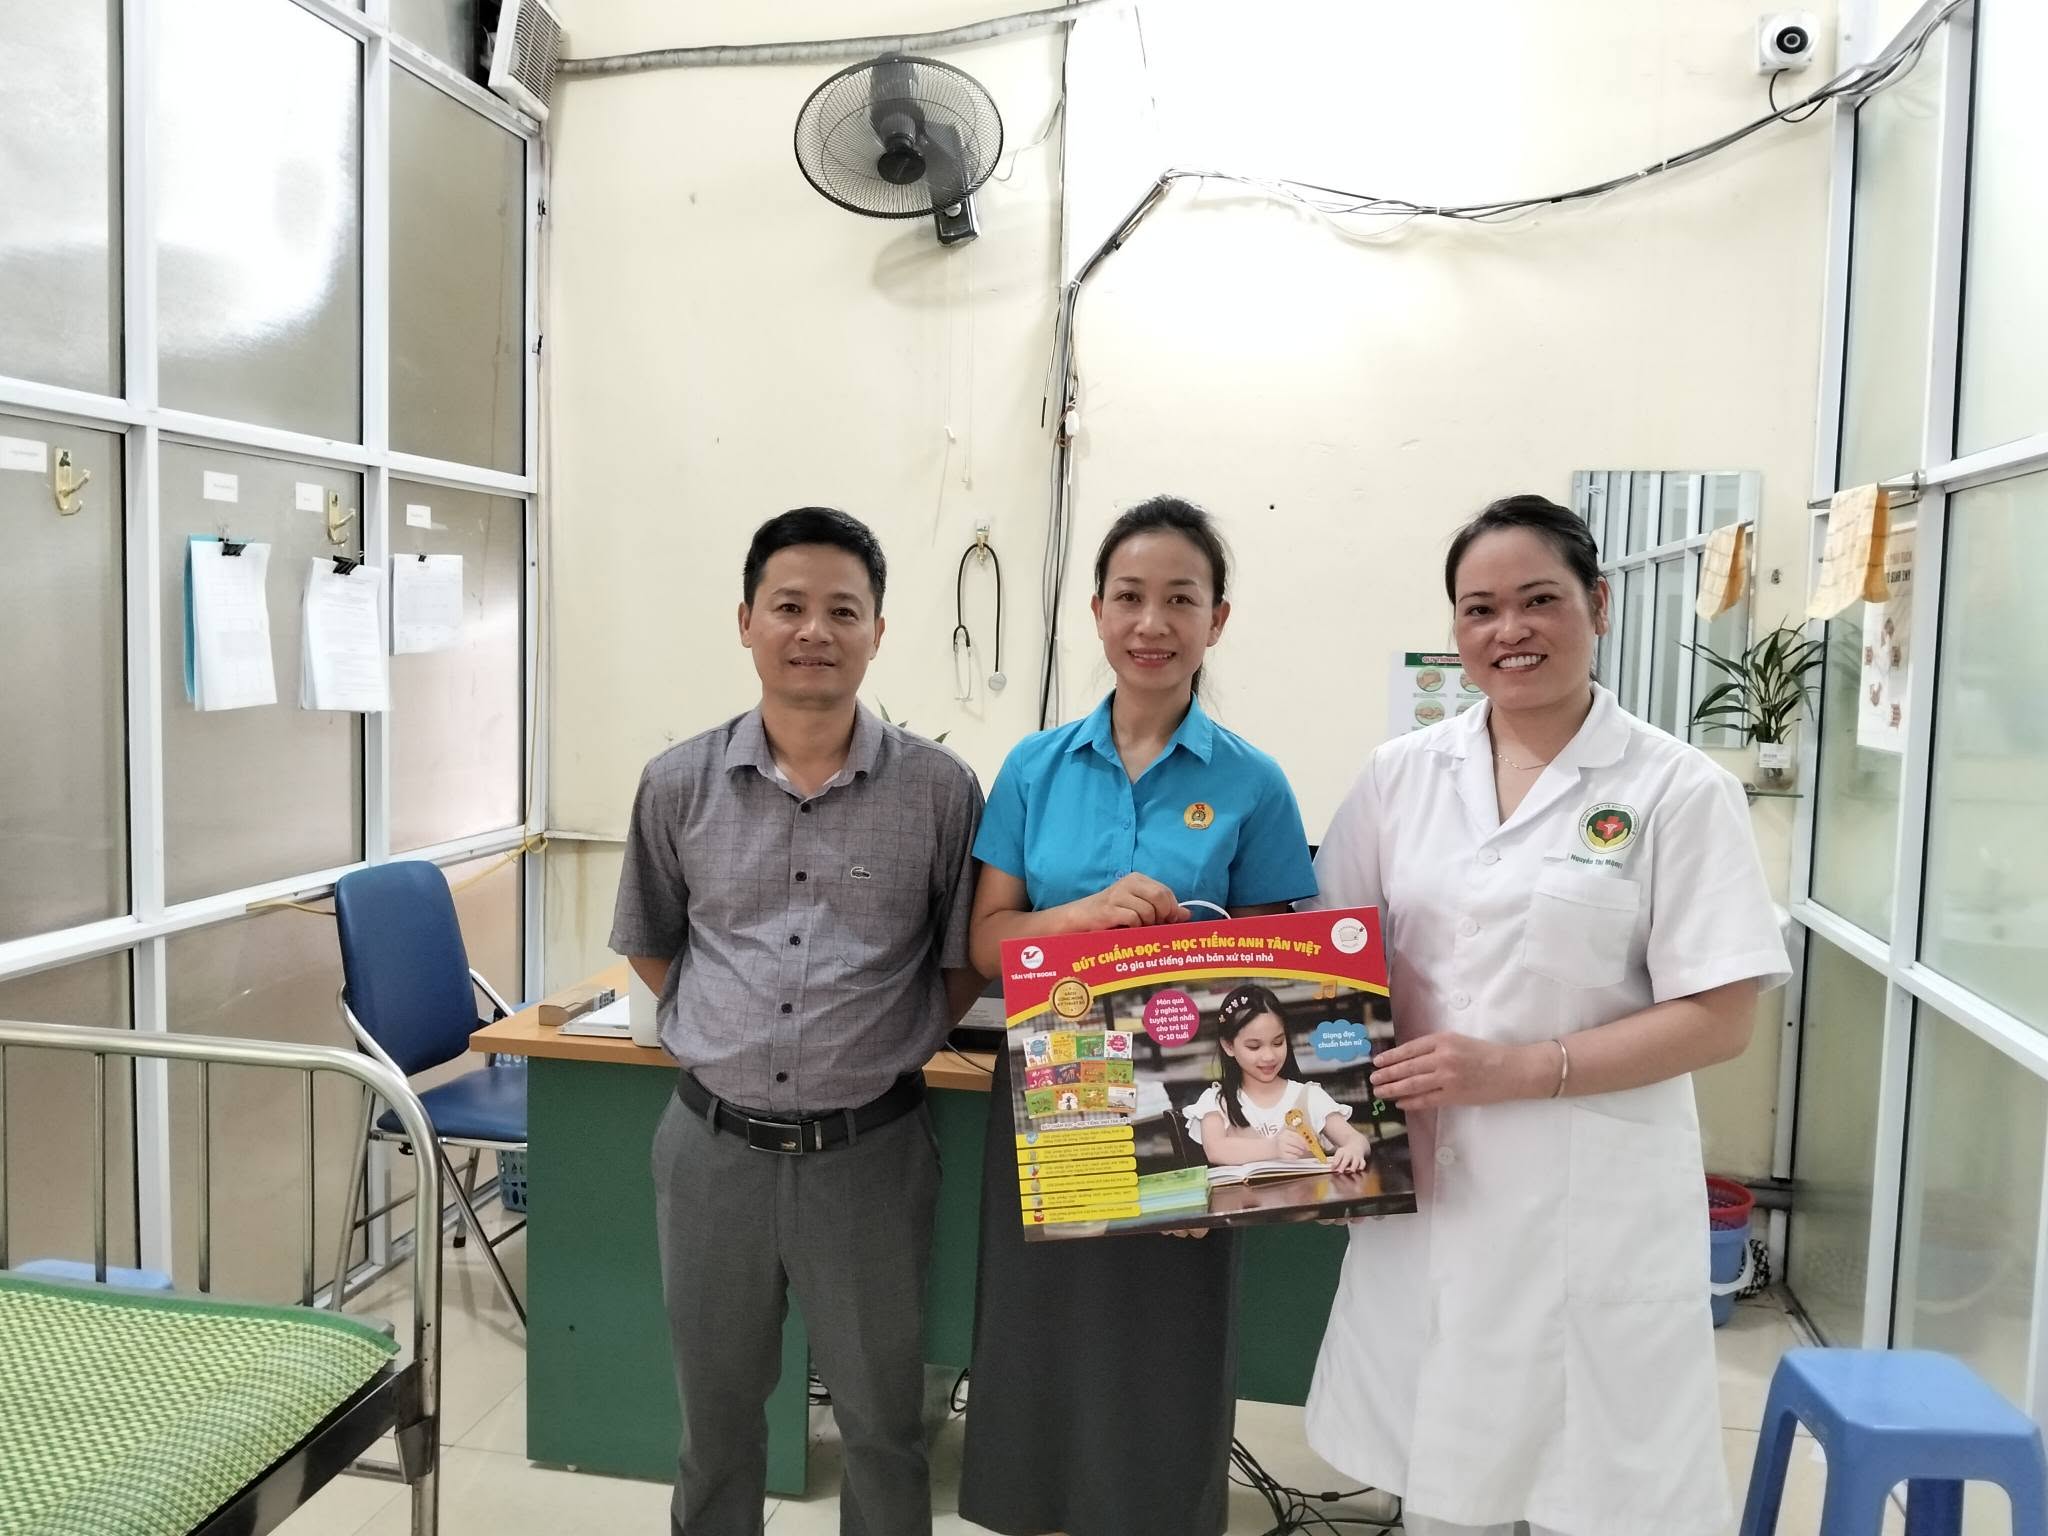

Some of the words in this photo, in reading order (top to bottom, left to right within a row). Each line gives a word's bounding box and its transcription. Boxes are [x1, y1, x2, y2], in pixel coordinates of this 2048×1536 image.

[1072, 956, 1096, 972] BÚT
[1097, 944, 1135, 965] CHẤM
[1134, 942, 1161, 957] ĐỌC
[1171, 938, 1198, 952] HỌC
[1199, 931, 1236, 948] TIẾNG
[1237, 937, 1264, 949] ANH
[1266, 936, 1291, 951] TÂN
[1293, 941, 1322, 957] VIỆT
[1129, 961, 1144, 972] gia
[1145, 958, 1158, 967] sư
[1158, 954, 1184, 966] tiếng
[1185, 953, 1205, 963] Anh
[1206, 953, 1224, 962] bản
[1225, 952, 1239, 962] xứ
[1240, 952, 1254, 964] tại
[1255, 952, 1274, 962] nhà
[1158, 1033, 1175, 1041] 0-10
[1175, 1031, 1189, 1039] tuổi
